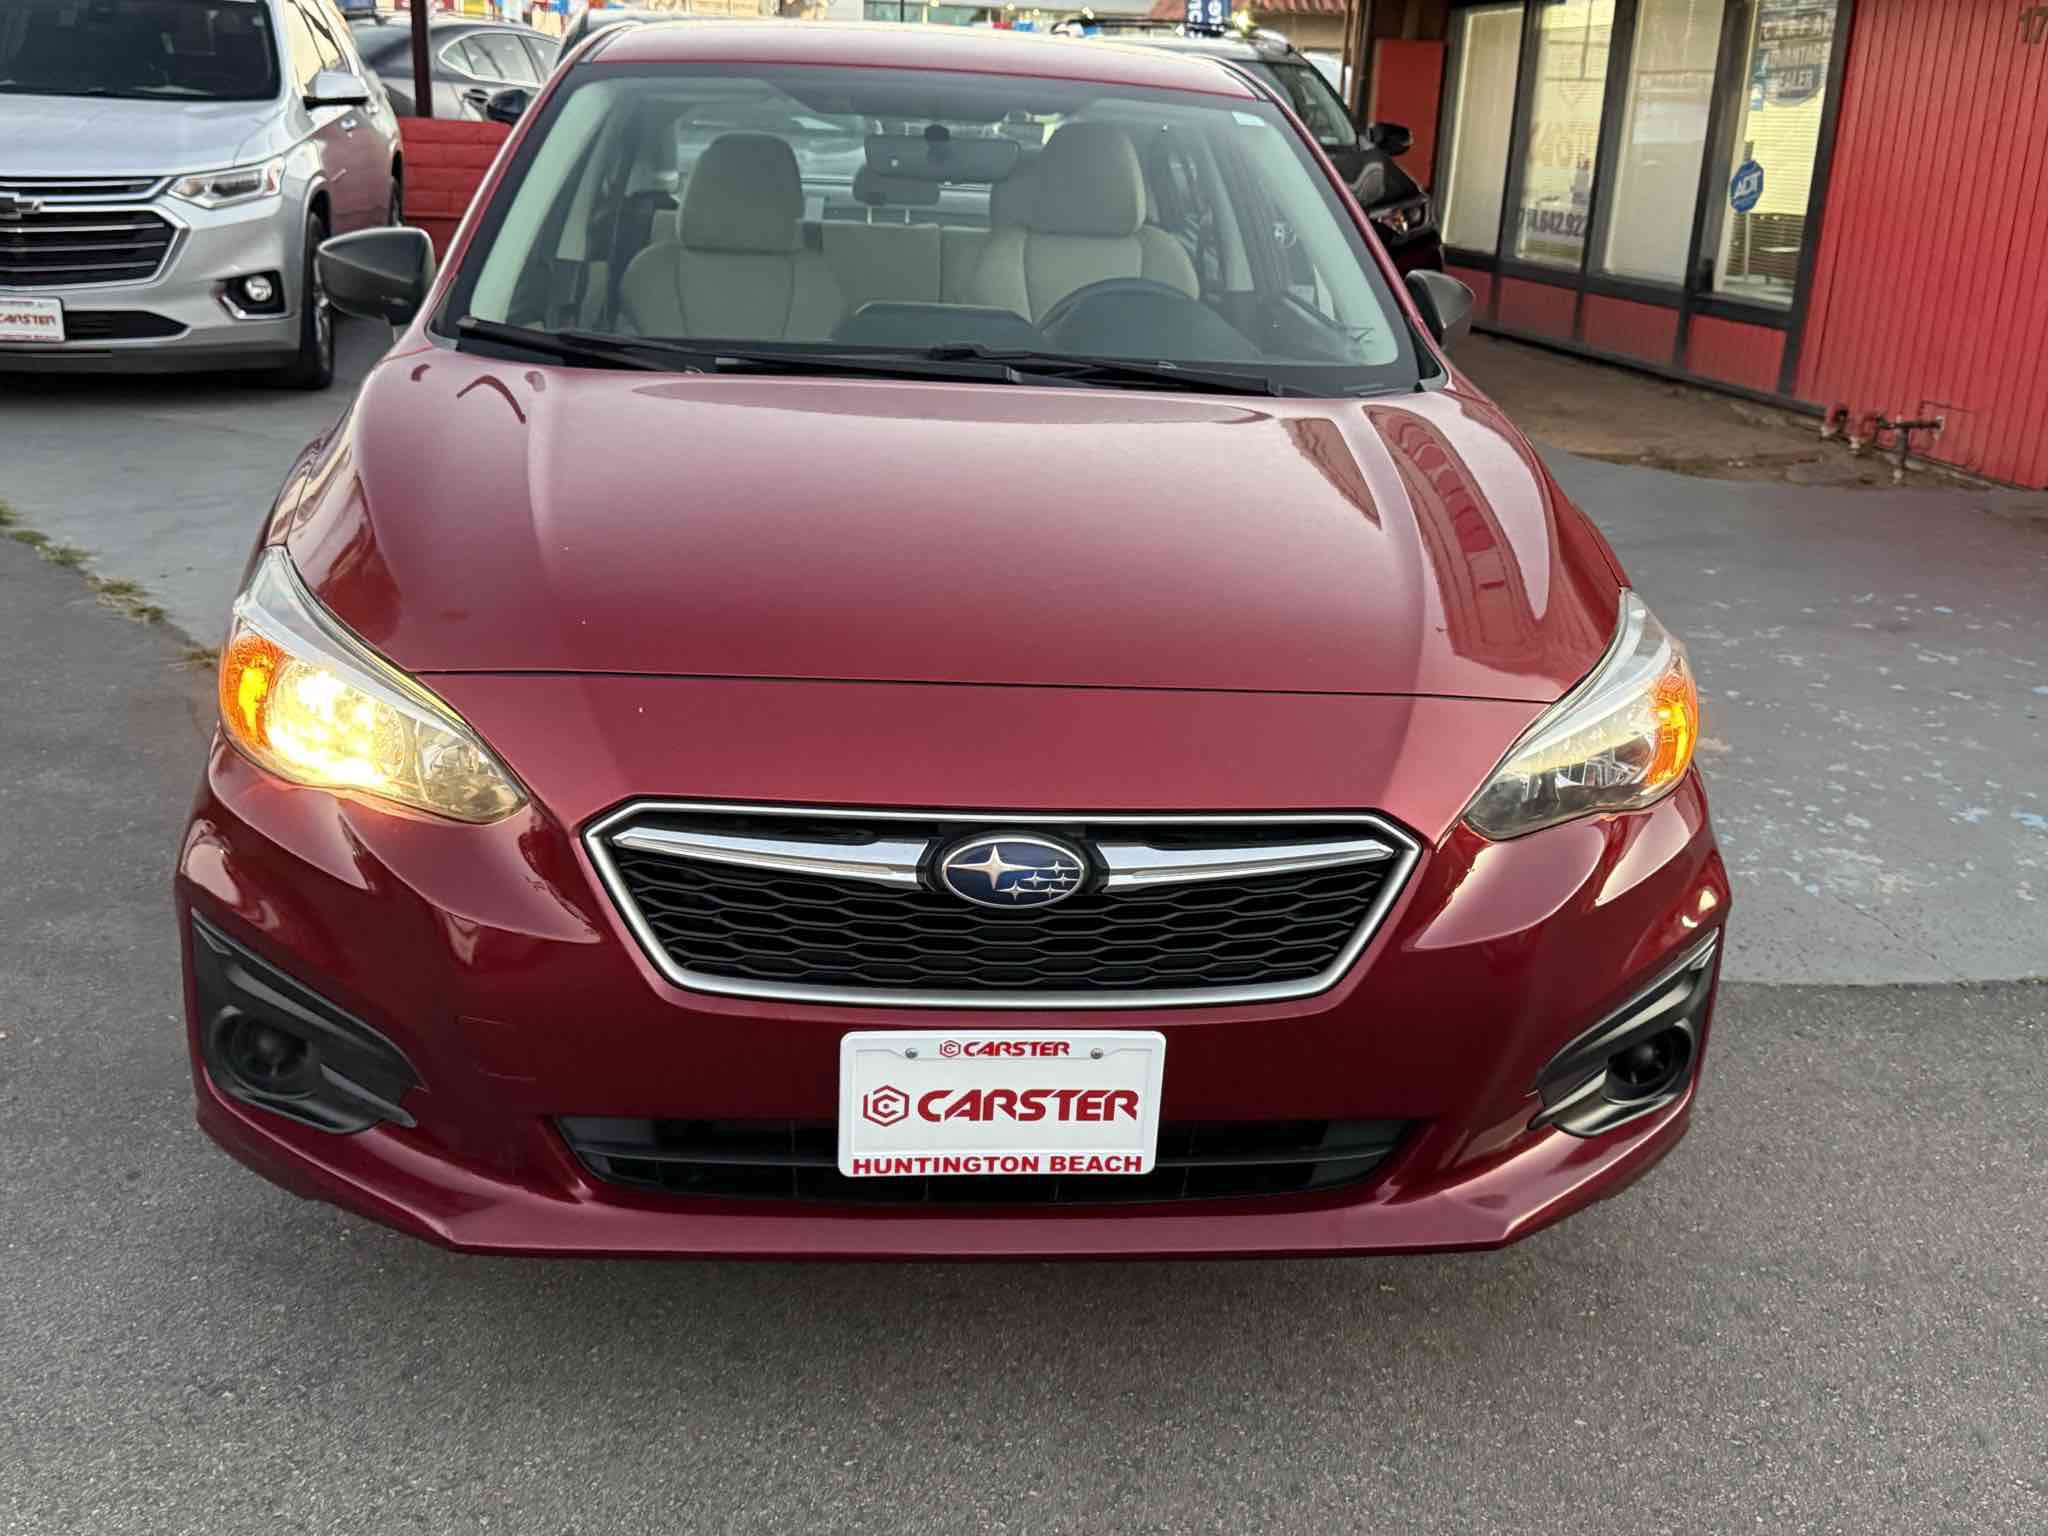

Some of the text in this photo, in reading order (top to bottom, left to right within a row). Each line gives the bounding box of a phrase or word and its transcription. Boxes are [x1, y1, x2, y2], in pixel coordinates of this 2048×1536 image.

[1734, 171, 1761, 199] ADT
[963, 1041, 1070, 1057] CARSTER
[917, 1088, 1140, 1122] CARSTER
[852, 1156, 1142, 1174] HUNTINGTON BEACH
